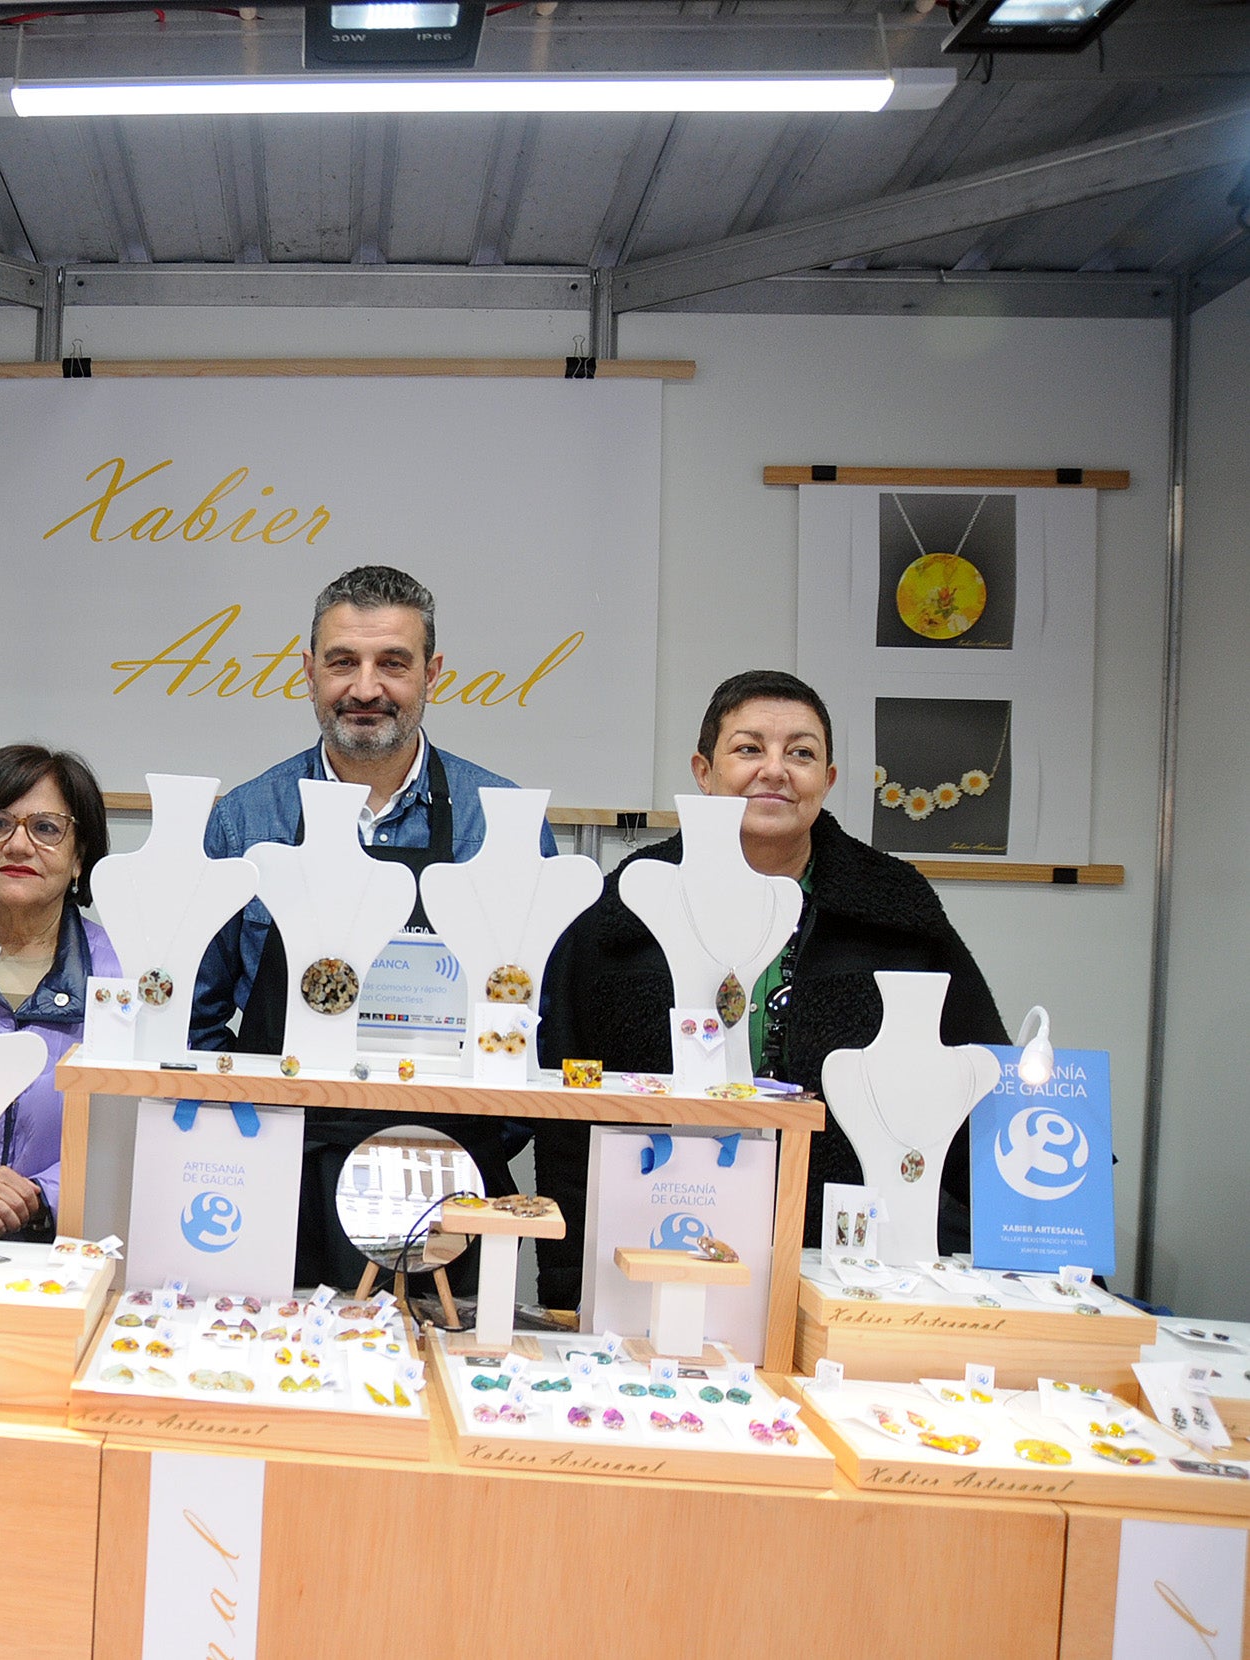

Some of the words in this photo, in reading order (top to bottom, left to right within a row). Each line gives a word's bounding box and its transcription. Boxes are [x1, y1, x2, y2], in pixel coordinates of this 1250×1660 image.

[331, 34, 367, 43] 30W
[42, 457, 332, 545] Xabier
[110, 603, 585, 708] Artenal
[370, 959, 411, 970] BANCA
[993, 1081, 1015, 1096] DE
[1019, 1082, 1088, 1098] GALICIA
[183, 1161, 246, 1175] ARTESANÍA
[182, 1172, 198, 1183] DE
[200, 1174, 246, 1187] GALICIA
[651, 1182, 717, 1195] ARTESANÍA
[651, 1194, 667, 1205] DE
[669, 1194, 716, 1207] GALICIA
[1002, 1224, 1033, 1233] XABIER
[1035, 1226, 1085, 1236] ARTESANAL
[828, 1307, 893, 1325] Xabier
[903, 1311, 1007, 1332] Artesanal
[466, 1444, 537, 1465] Xabier
[549, 1449, 667, 1474] Artesanal
[864, 1466, 940, 1487] Xabier
[952, 1471, 1075, 1493] Artesanal
